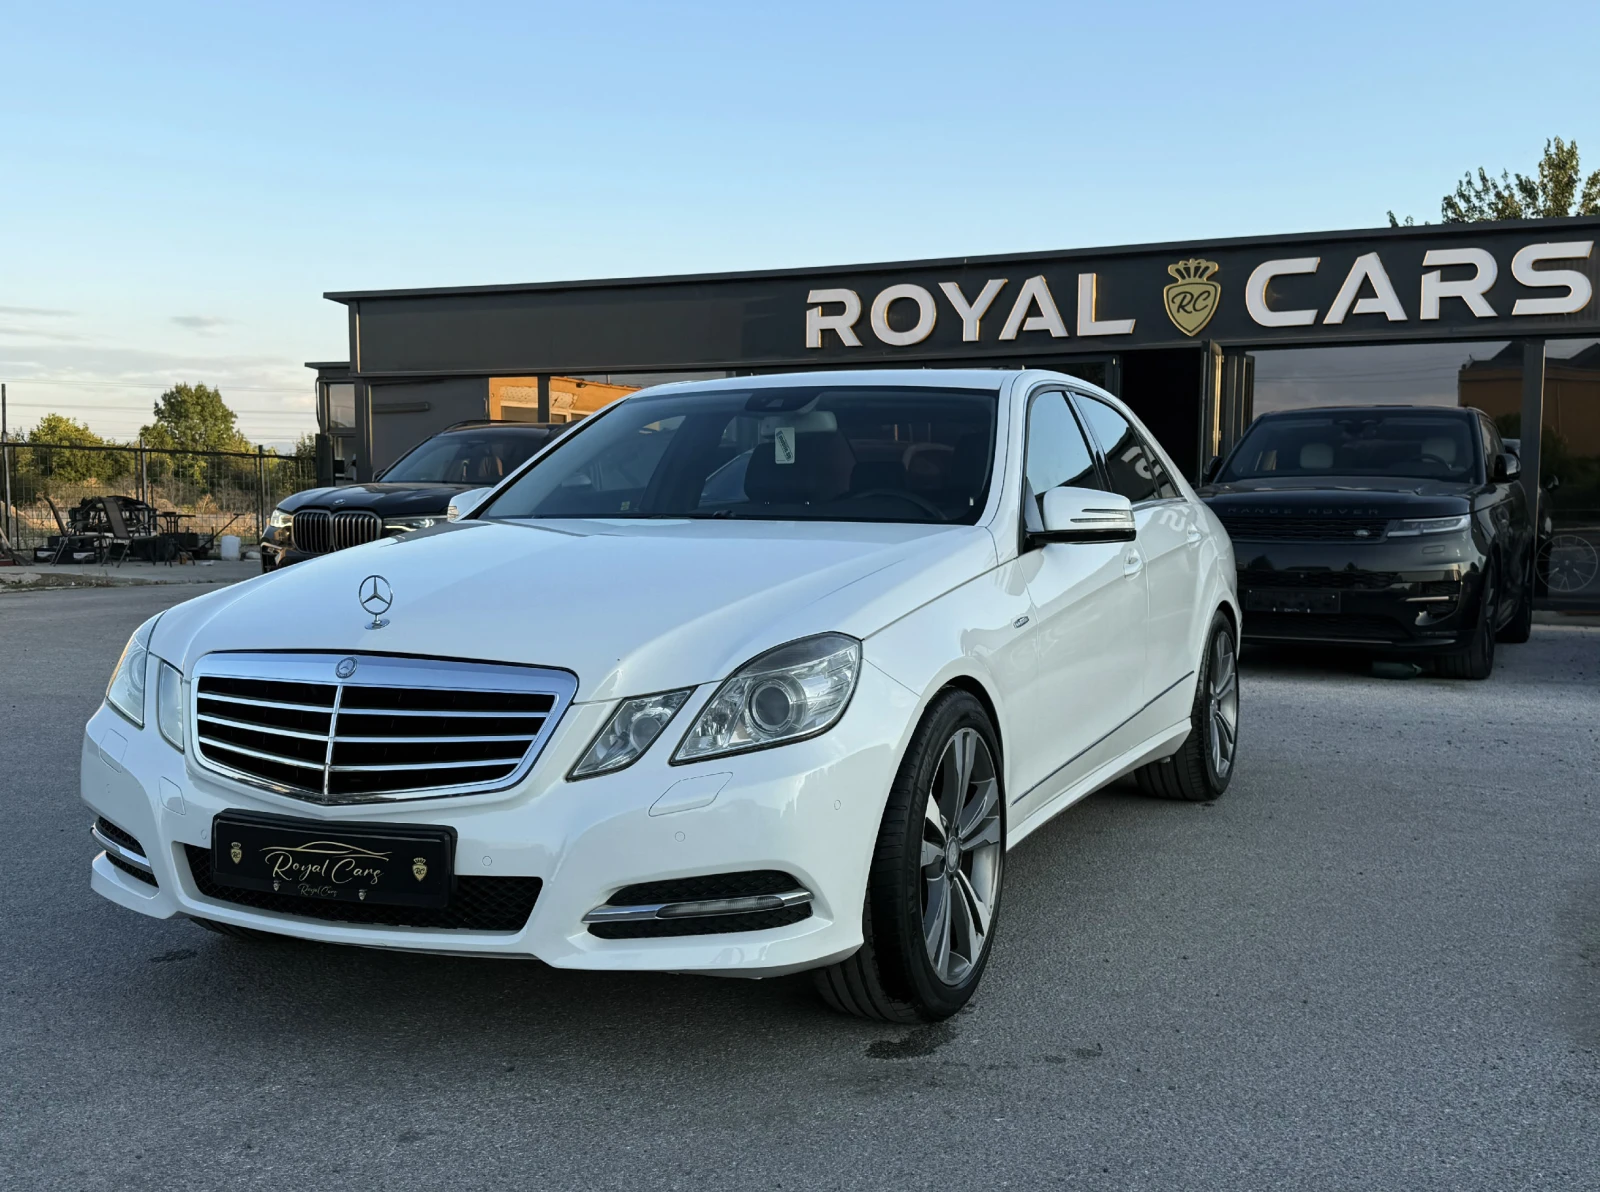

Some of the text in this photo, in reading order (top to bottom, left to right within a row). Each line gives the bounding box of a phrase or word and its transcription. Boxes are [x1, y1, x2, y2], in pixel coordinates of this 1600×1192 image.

[806, 240, 1594, 348] ROYAL CARS
[1171, 290, 1211, 315] RC
[265, 851, 384, 885] Royal Cars
